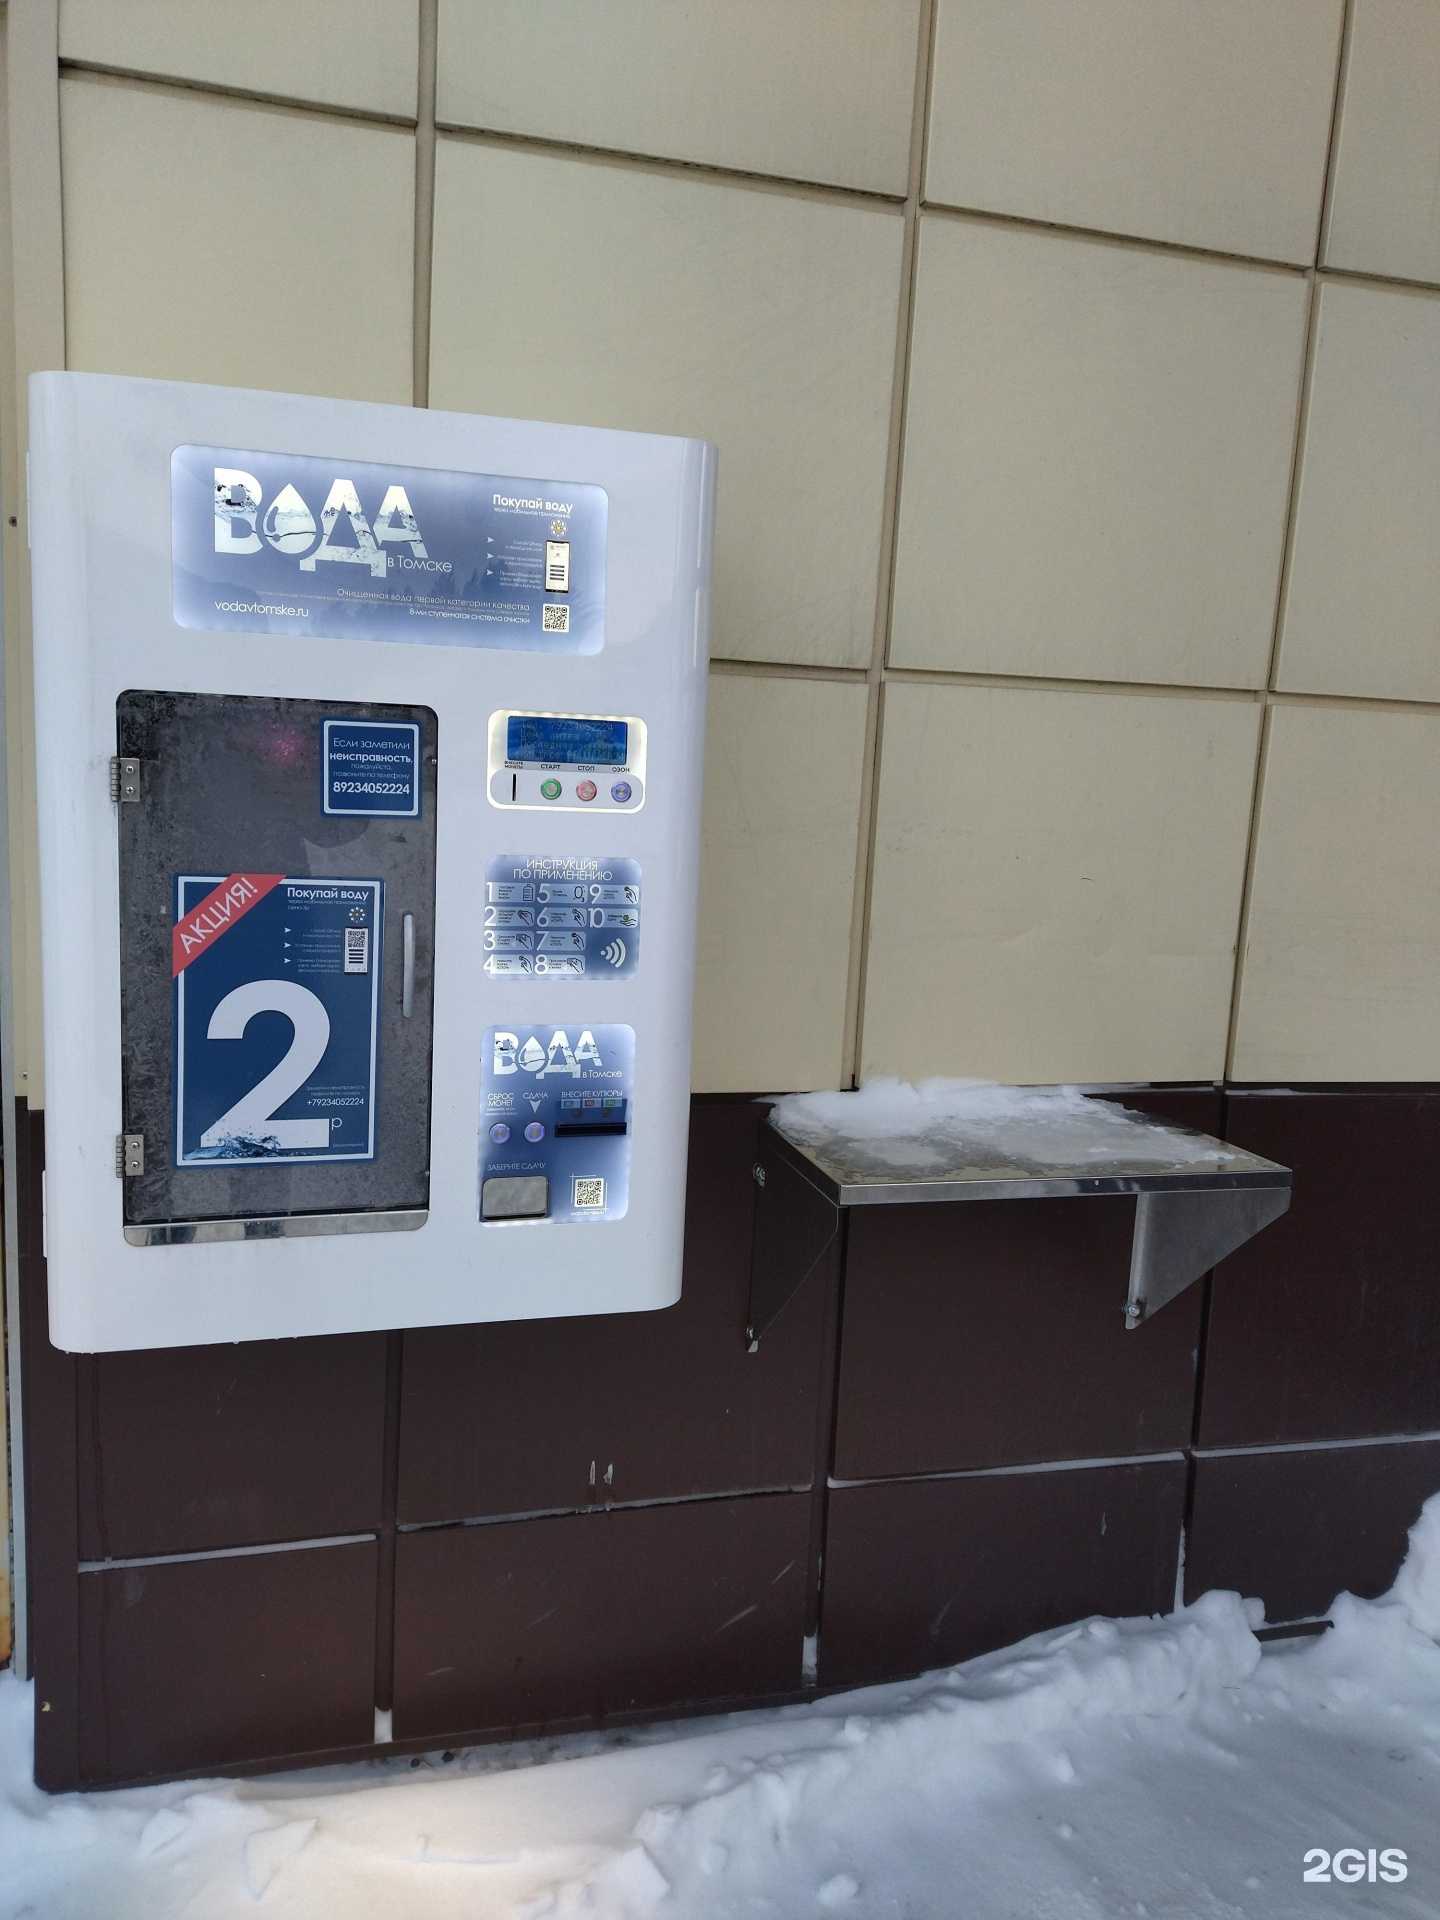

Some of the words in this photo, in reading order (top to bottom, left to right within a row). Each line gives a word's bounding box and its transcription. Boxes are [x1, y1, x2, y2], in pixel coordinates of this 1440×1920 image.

[493, 494, 543, 509] Покупай
[545, 501, 573, 513] воду
[214, 467, 428, 578] ВОДА
[387, 557, 394, 567] в
[399, 557, 453, 573] Томске
[214, 600, 309, 617] vodavtomske.ru
[337, 588, 389, 599] Очищенная
[391, 593, 412, 602] вода
[447, 599, 491, 609] категории
[492, 602, 530, 611] качества
[333, 738, 359, 747] Если
[360, 740, 410, 750] заметили
[333, 781, 410, 795] 89234052224
[513, 869, 531, 879] ПО
[533, 870, 613, 881] ПРИМЕНЕНИЮ
[526, 860, 598, 870] ИНСТРУКЦИЯ
[287, 887, 338, 900] Покупай
[340, 890, 369, 901] воду
[486, 881, 493, 903] 1
[536, 883, 551, 904] 5
[589, 884, 601, 905] 9
[179, 877, 259, 954] АКЦИЯ!
[484, 905, 497, 927] 2
[536, 907, 549, 928] 6
[588, 907, 605, 928] 10
[483, 929, 496, 951] 3
[535, 931, 550, 951] 7
[483, 954, 496, 975] 4
[534, 954, 548, 975] 8
[200, 979, 331, 1148] 2
[493, 1030, 603, 1079] ВОДА
[589, 1070, 623, 1078] Томске
[307, 1097, 364, 1106] +79234052224
[487, 1092, 514, 1100] СБРОС
[522, 1091, 549, 1100] СДАЧА
[521, 1162, 546, 1170] СДАЧУ
